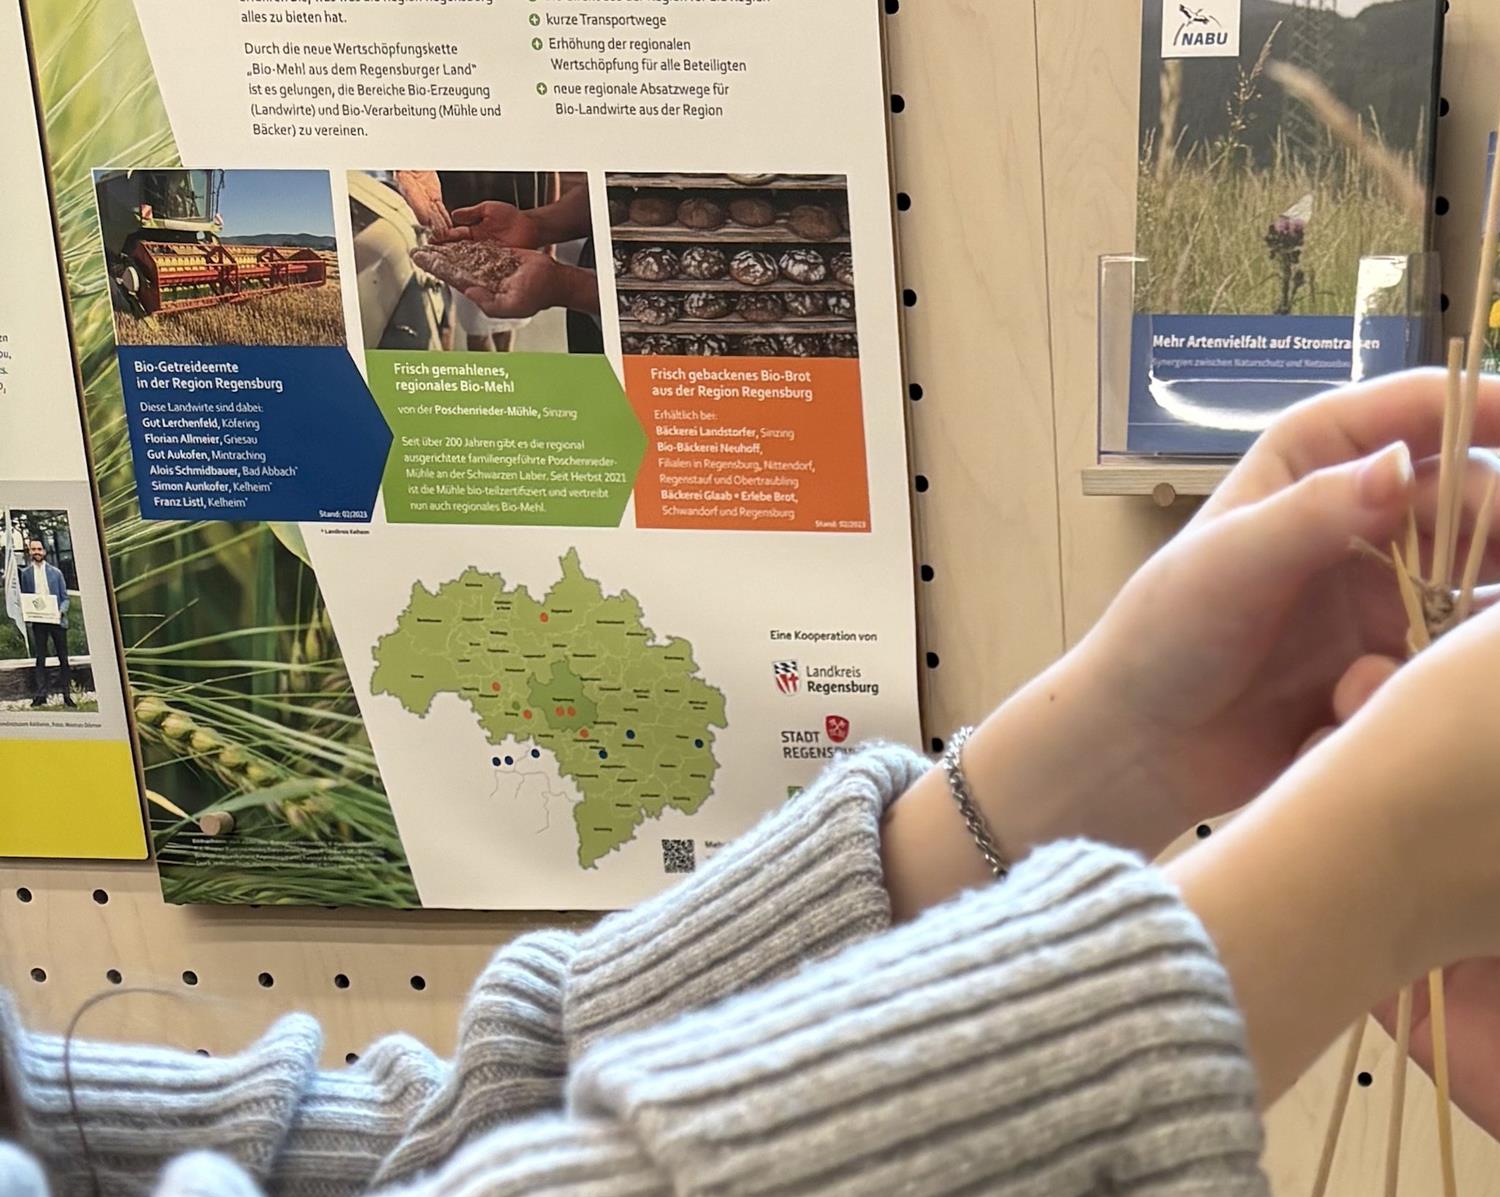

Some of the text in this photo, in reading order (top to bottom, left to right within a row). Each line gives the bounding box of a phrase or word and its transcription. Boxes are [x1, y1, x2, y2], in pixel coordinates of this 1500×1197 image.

[241, 12, 347, 23] alles zu bieten hat.
[546, 14, 666, 29] kurze Transportwege
[1182, 32, 1228, 46] NABU
[244, 43, 458, 58] Durch die neue Wertschöpfungskette
[549, 38, 690, 53] Erhöhung der regionalen
[309, 66, 328, 76] aus
[331, 64, 356, 76] dem
[360, 64, 439, 78] Regensburger
[551, 59, 746, 74] Wertschöpfung für alle Beteiligten
[250, 84, 490, 99] ist es gelungen, die Bereiche Bio-Erzeugung
[554, 83, 728, 97] neue regionale Absatzwege für
[250, 104, 501, 119] (Landwirte) und Bio-Verarbeitung (Mühle und
[556, 104, 723, 119] Bio-Landwirte aus der Region
[253, 124, 368, 138] Bäcker) zu vereinen.
[1153, 335, 1185, 348] Mehr
[1187, 335, 1266, 348] Artenvielfalt
[1270, 337, 1291, 348] auf
[135, 361, 239, 373] Bio-Getreideernte
[394, 363, 509, 379] Frisch gemahlenes,
[651, 368, 811, 383] Frisch gebackenes Bio-Brot
[137, 378, 283, 392] in der Region Regensburg
[396, 381, 514, 393] regionales Bio-Mehl
[652, 386, 813, 400] aus der Region Regensburg
[140, 402, 264, 413] Diese Landwirte sind dabei:
[417, 406, 433, 414] der
[435, 406, 541, 418] Poschenrieder-Mühle,
[142, 418, 160, 428] Gut
[162, 418, 220, 430] Lerchenfeld,
[656, 426, 697, 436] Bäckerei
[145, 434, 178, 444] Florian
[180, 434, 222, 445] Allmeier,
[422, 438, 442, 447] über
[445, 438, 462, 447] 200
[465, 438, 495, 448] Jahren
[497, 438, 516, 450] gibt
[518, 441, 528, 449] es
[530, 439, 545, 449] die
[546, 440, 584, 452] regional
[658, 442, 718, 452] Bio-Bäckerei
[147, 450, 165, 459] Gut
[167, 450, 210, 461] Aukofen,
[150, 466, 173, 475] Alois
[175, 466, 240, 477] Schmidbauer,
[243, 467, 260, 476] Bad
[450, 470, 465, 479] der
[605, 473, 626, 482] 2021
[152, 481, 183, 491] Simon
[661, 490, 702, 500] Bäckerei
[154, 497, 181, 507] Franz
[770, 631, 877, 642] Eine Kooperation von
[806, 666, 861, 678] Landkreis
[807, 681, 879, 695] Regensburg
[782, 731, 820, 742] STADT
